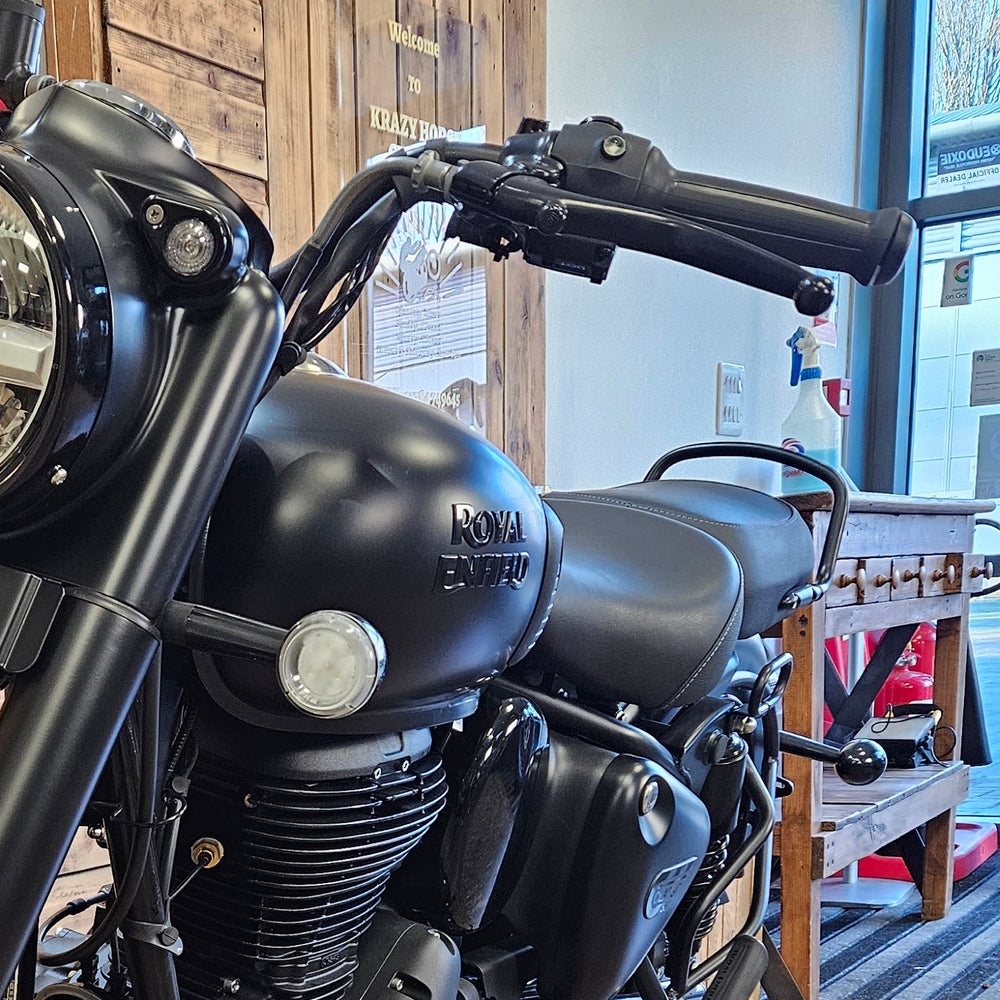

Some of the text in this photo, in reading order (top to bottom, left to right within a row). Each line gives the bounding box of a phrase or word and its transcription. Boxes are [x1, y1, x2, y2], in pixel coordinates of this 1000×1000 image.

[388, 19, 440, 58] Welcome
[369, 104, 417, 141] KRAZY
[450, 503, 527, 549] ROYAL
[432, 552, 530, 595] ENFIELD
